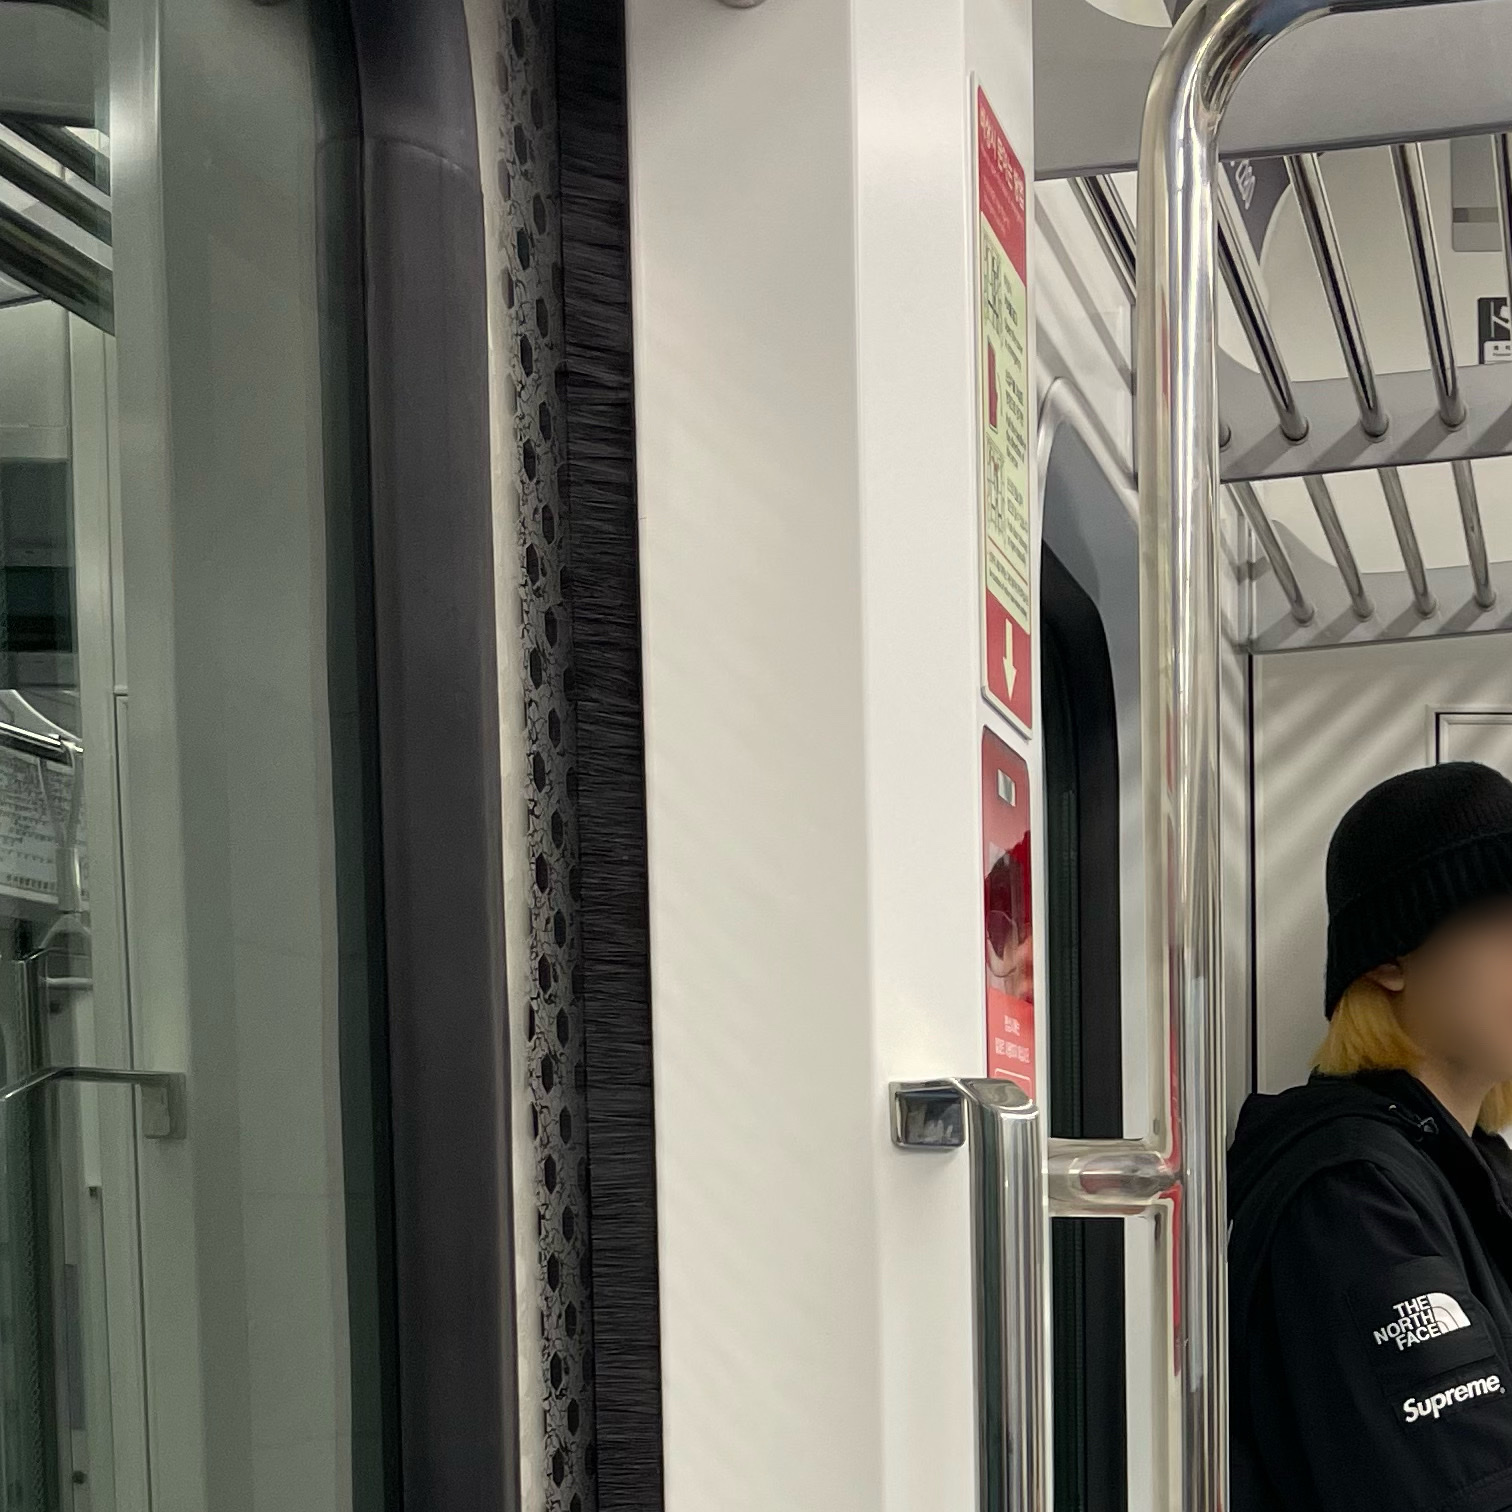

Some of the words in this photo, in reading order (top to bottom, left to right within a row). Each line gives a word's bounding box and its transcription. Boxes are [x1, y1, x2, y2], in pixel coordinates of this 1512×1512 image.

[1392, 1294, 1431, 1318] THE
[1372, 1309, 1436, 1346] NORTH
[1395, 1320, 1442, 1351] FACE
[1402, 1374, 1501, 1423] Supreme
